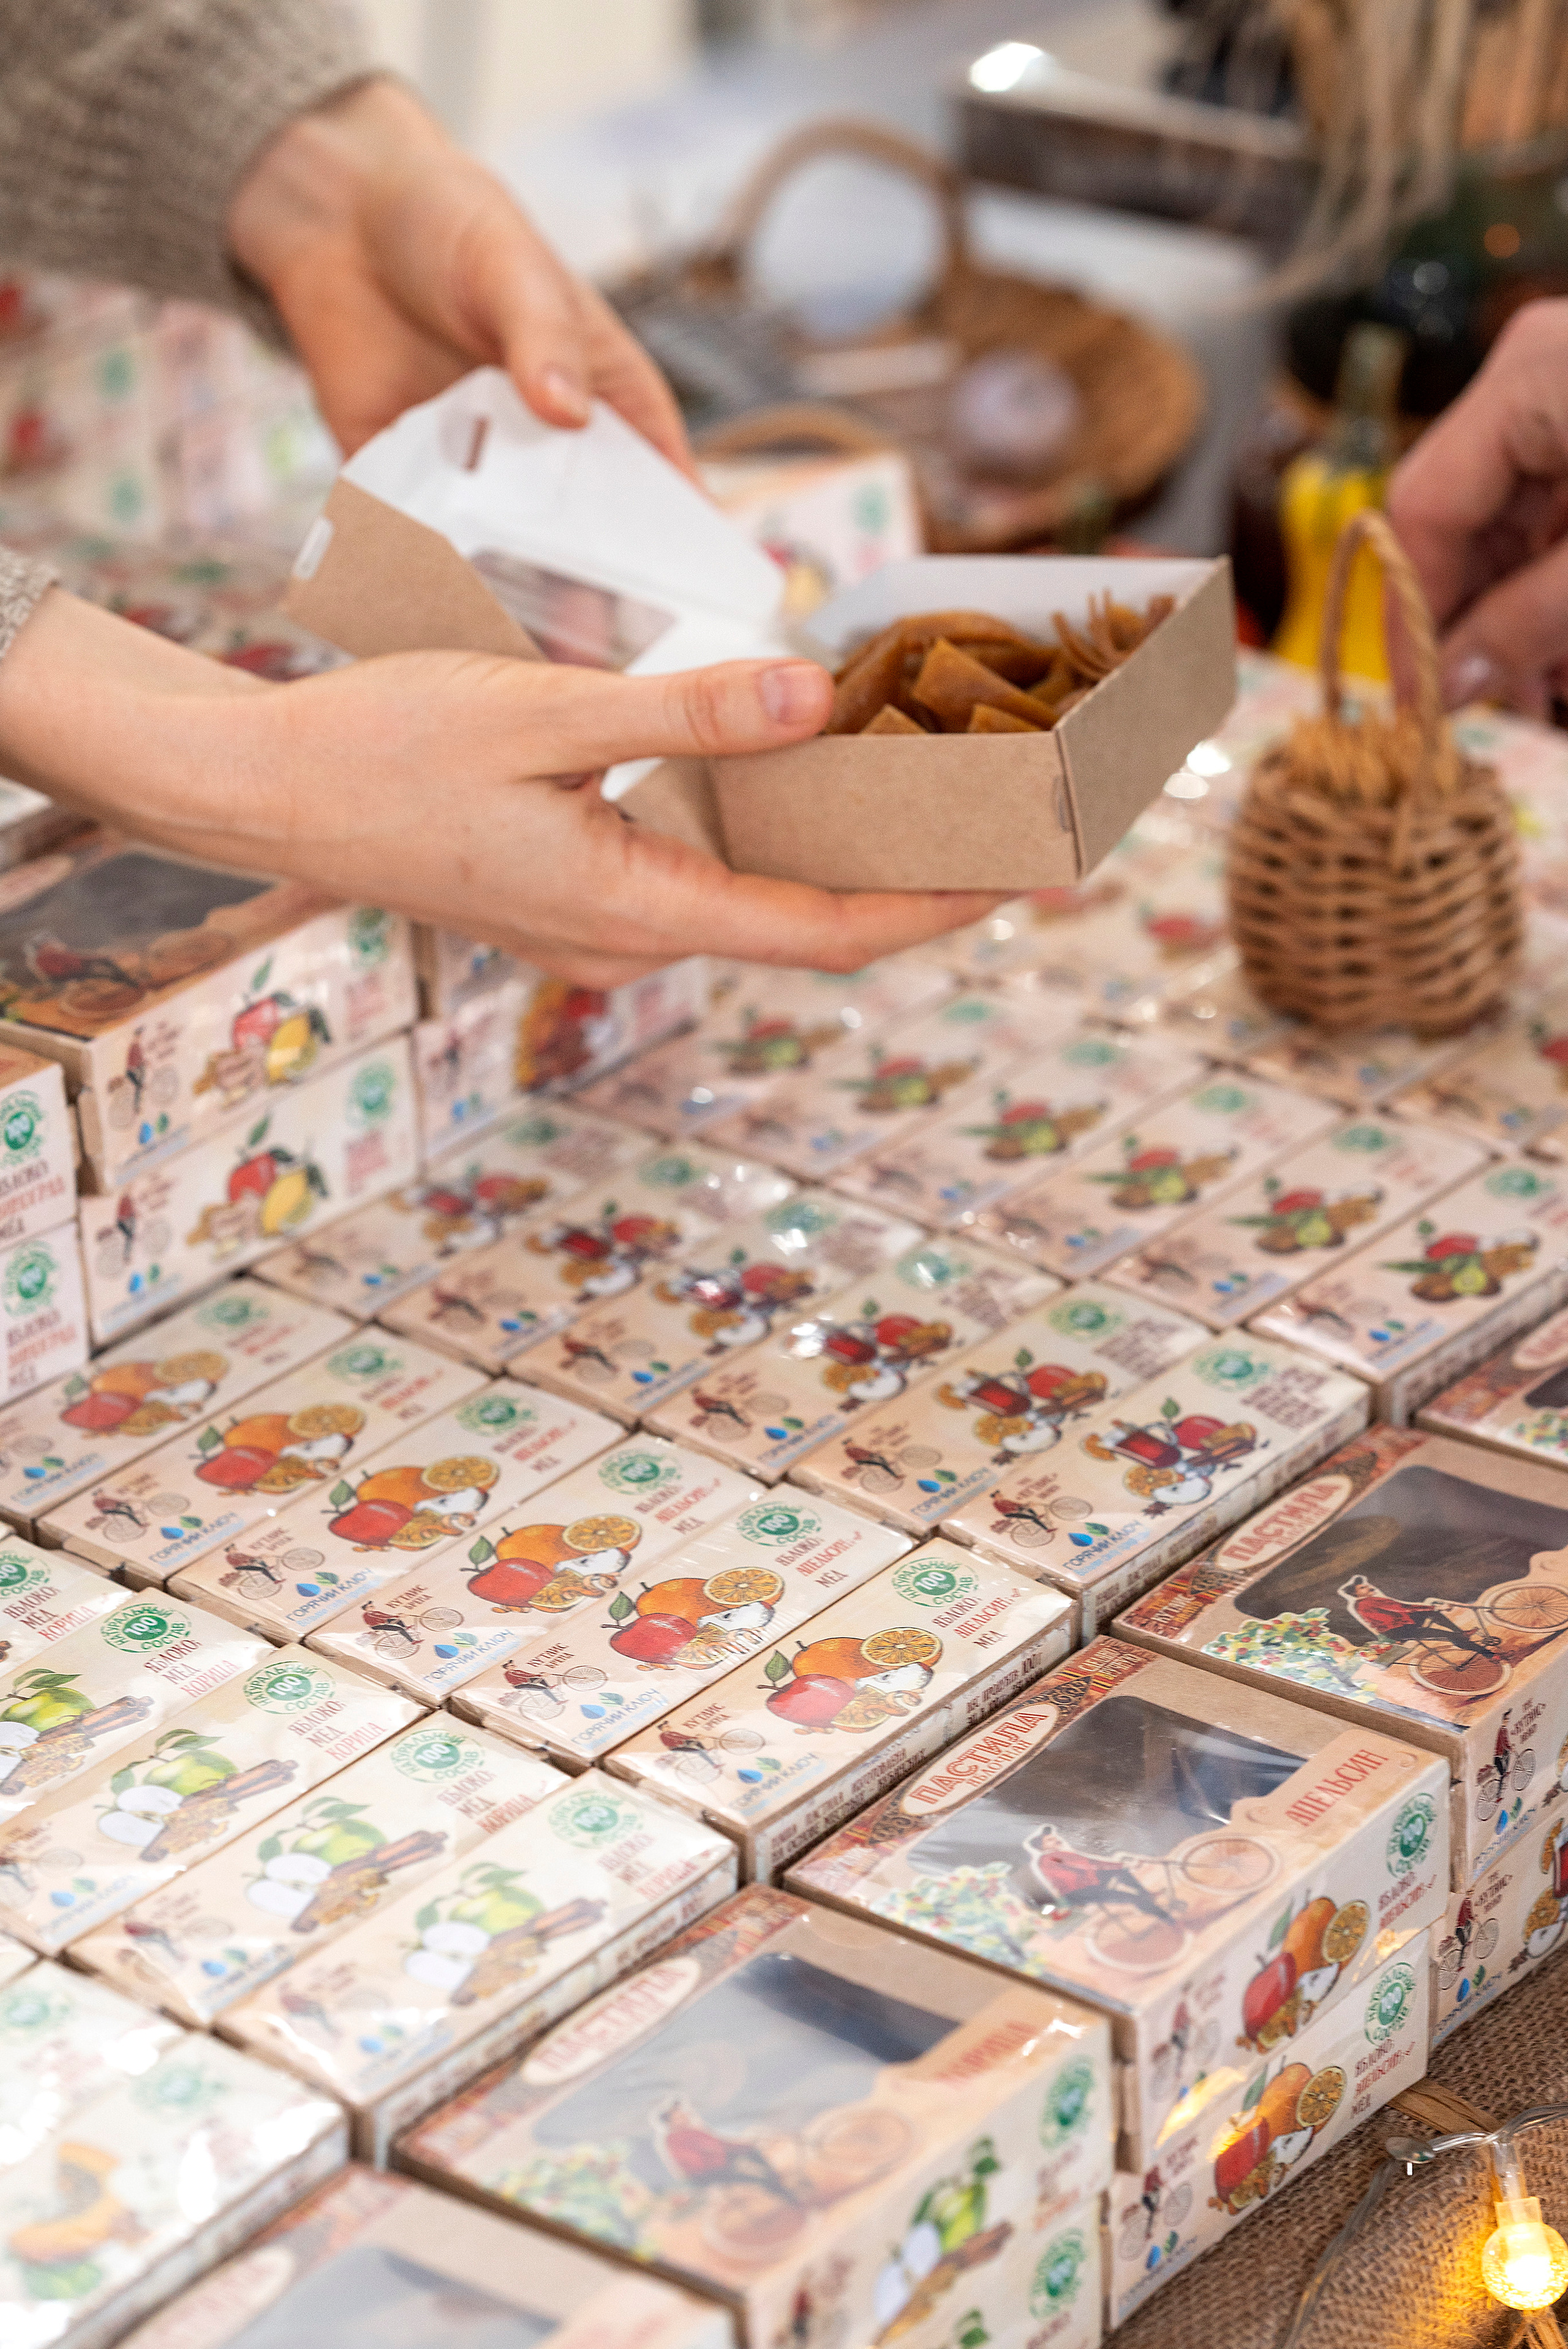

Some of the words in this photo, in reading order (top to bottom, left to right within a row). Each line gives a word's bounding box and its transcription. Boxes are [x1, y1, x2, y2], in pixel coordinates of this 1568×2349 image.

[915, 1572, 947, 1590] 100
[933, 1576, 974, 1605] СОСТАВ
[385, 1584, 429, 1609] КУТАИС
[37, 1605, 99, 1642] КОРИЦА
[124, 1617, 159, 1636] 100
[141, 1623, 186, 1650] СОСТАВ
[526, 1642, 570, 1668] КУТАИС
[179, 1660, 241, 1698] КОРИЦА
[267, 1676, 303, 1696] 100
[285, 1682, 330, 1711] СОСТАВ
[325, 1722, 388, 1761] КОРИЦА
[415, 1742, 450, 1764] 100
[909, 1712, 1050, 1804] ПАСТИЛА
[966, 1739, 1033, 1787] ЯБЛОЧНАЯ
[1285, 1749, 1389, 1826] АПЕЛЬСИН
